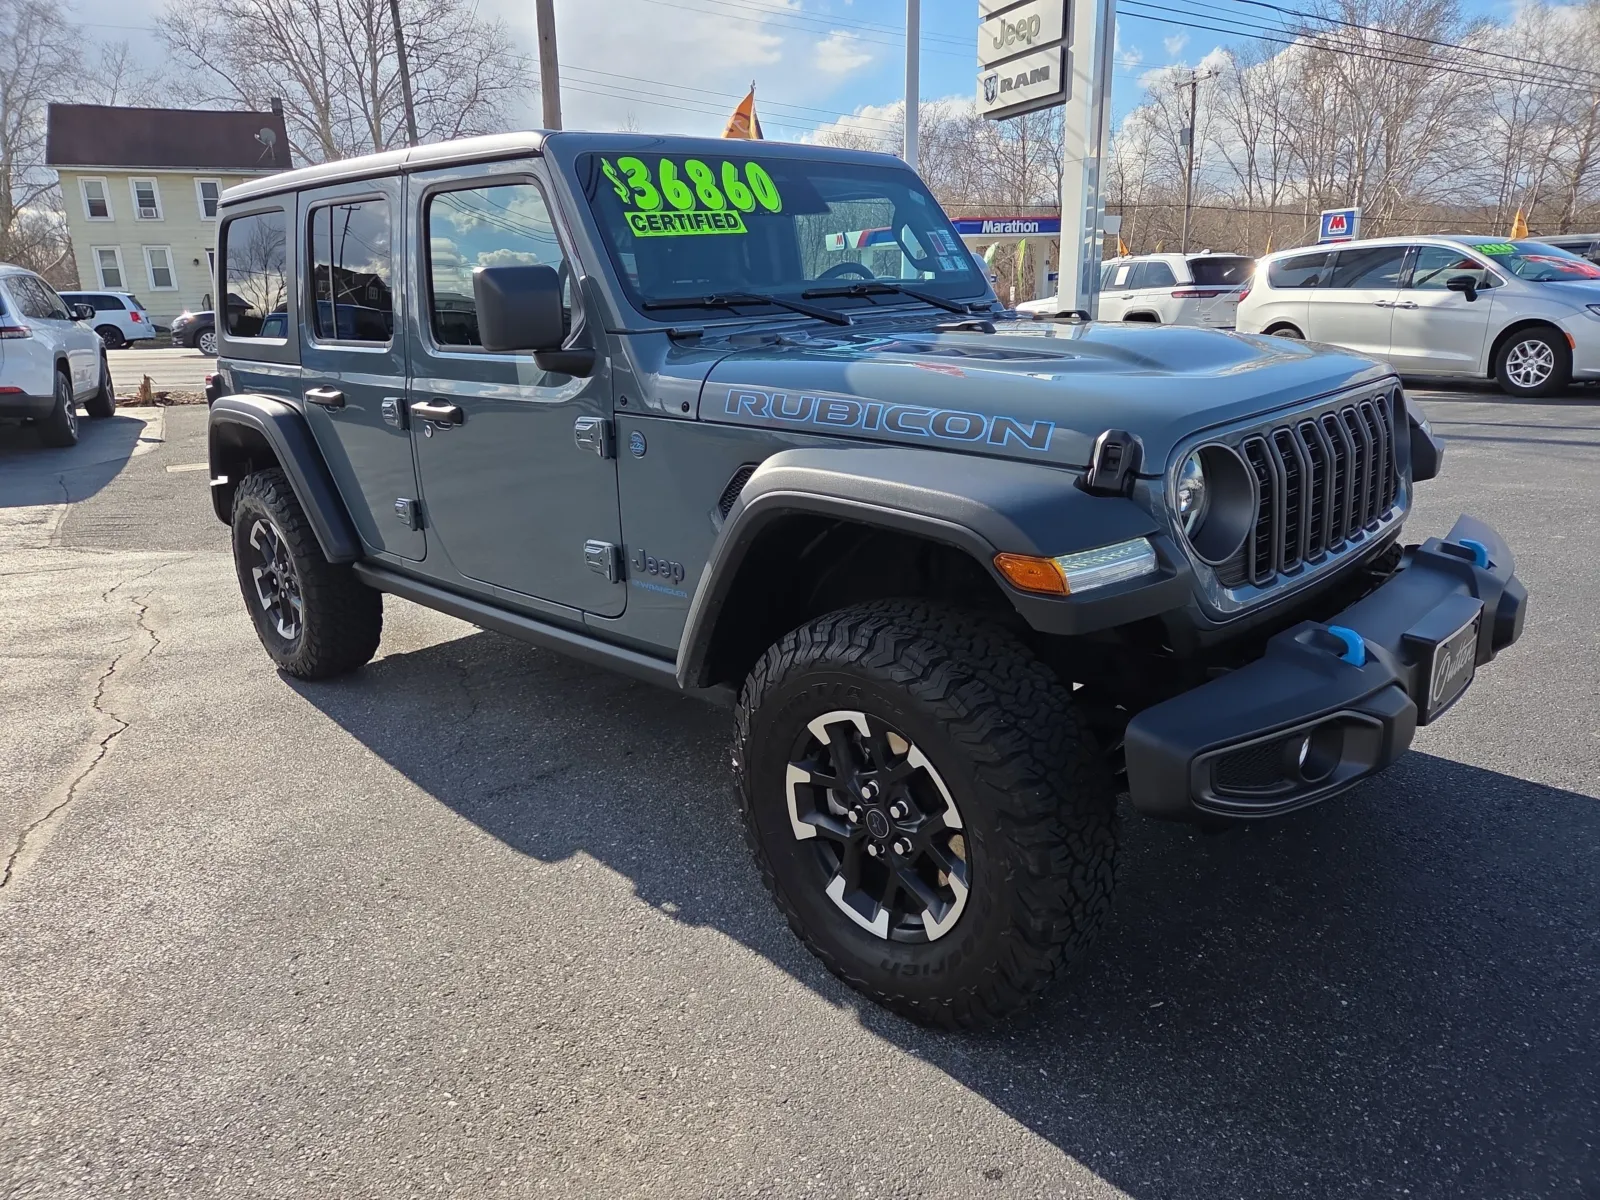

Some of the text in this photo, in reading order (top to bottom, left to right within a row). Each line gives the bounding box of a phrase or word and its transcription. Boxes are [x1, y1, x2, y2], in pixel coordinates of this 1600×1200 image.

[993, 14, 1040, 49] Jeep
[1000, 65, 1050, 93] RAM
[600, 156, 783, 213] $36860
[629, 211, 739, 233] CERTIFIED
[981, 220, 1039, 234] Marathon
[724, 388, 1055, 452] RUBICON
[631, 547, 685, 586] Jeep
